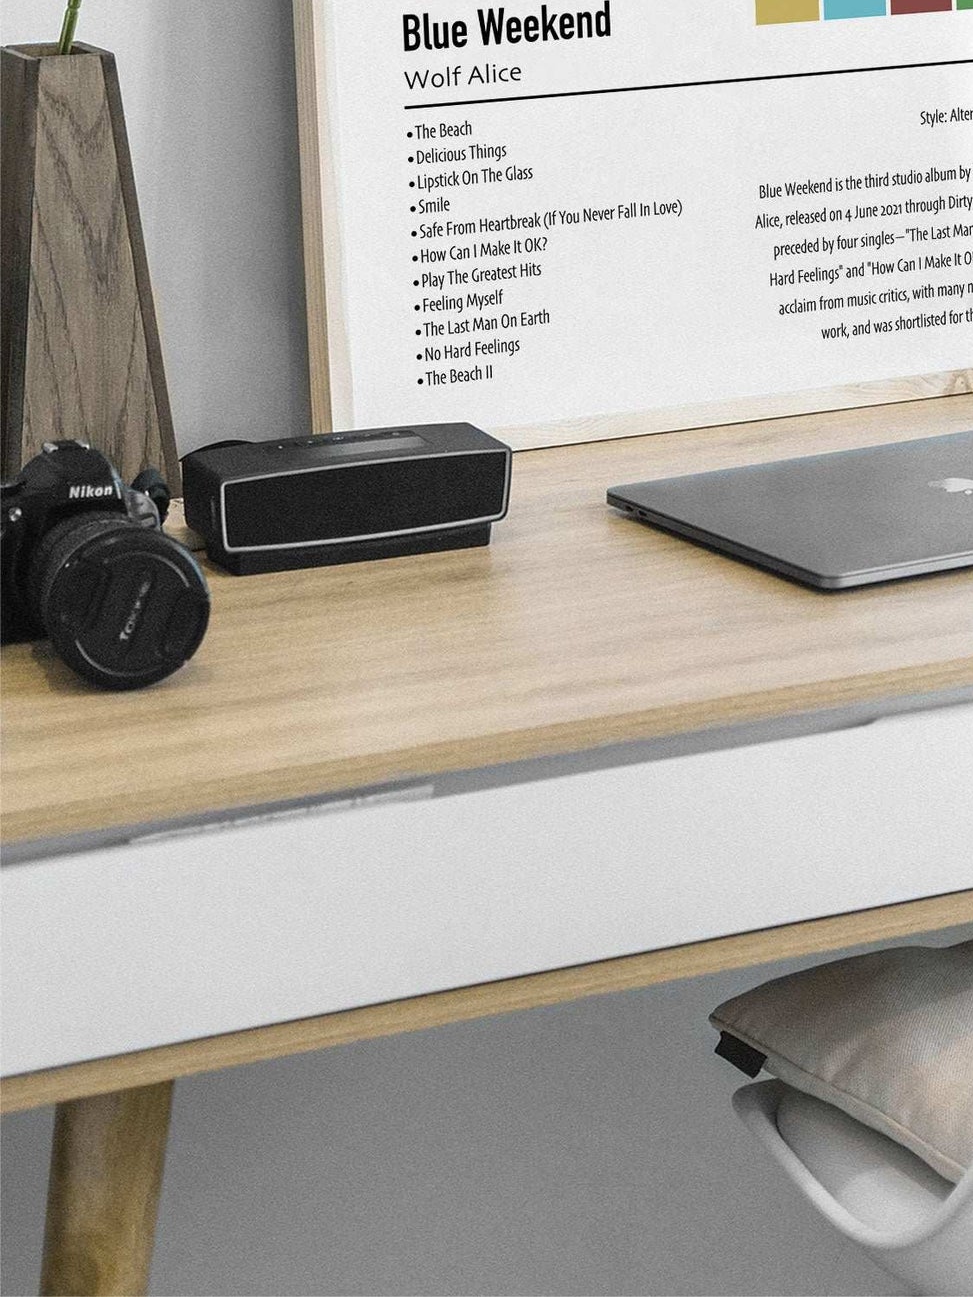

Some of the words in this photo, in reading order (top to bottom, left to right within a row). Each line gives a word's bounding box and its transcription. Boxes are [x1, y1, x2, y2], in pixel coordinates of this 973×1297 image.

[402, 12, 468, 53] Blue
[476, 0, 612, 46] Weekend
[403, 65, 462, 91] Wolf
[467, 62, 522, 86] Alice
[414, 123, 437, 140] The
[439, 119, 473, 139] Beach
[919, 108, 948, 129] Style:
[415, 147, 467, 165] Delicious
[467, 143, 507, 162] Things
[417, 170, 461, 194] Lipstick
[461, 169, 479, 186] On
[480, 166, 503, 184] The
[505, 164, 534, 182] Glass
[758, 183, 783, 200] Blue
[784, 176, 833, 197] Weekend
[834, 177, 844, 192] is
[845, 174, 863, 191] the
[864, 171, 890, 189] third
[891, 169, 923, 187] studio
[924, 166, 957, 184] album
[958, 164, 972, 183] by
[418, 195, 451, 215] Smile
[419, 221, 444, 240] Safe
[446, 220, 477, 237] From
[479, 211, 542, 233] Heartbreak
[543, 209, 558, 231] (If
[558, 210, 581, 226] You
[582, 207, 616, 223] Never
[617, 202, 637, 220] Fall
[639, 202, 651, 218] In
[653, 198, 683, 218] Love)
[754, 212, 784, 230] Alice,
[785, 206, 827, 227] released
[829, 209, 843, 222] on
[844, 208, 853, 223] 4
[854, 204, 879, 220] June
[880, 203, 903, 217] 2021
[904, 195, 946, 216] through
[948, 194, 973, 212] Dirty
[420, 248, 447, 264] How
[449, 245, 471, 261] Can
[473, 243, 478, 259] I
[479, 240, 511, 258] Make
[513, 239, 523, 255] It
[524, 236, 548, 254] OK?
[773, 237, 820, 262] preceded
[821, 236, 835, 256] by
[836, 234, 860, 251] four
[930, 225, 952, 240] Last
[421, 271, 446, 291] Play
[446, 268, 469, 286] The
[471, 265, 518, 283] Greatest
[519, 262, 542, 278] Hits
[769, 269, 796, 287] Hard
[797, 264, 844, 285] Feelings"
[845, 261, 865, 279] and
[866, 260, 895, 276] "How
[896, 258, 916, 273] Can
[918, 256, 922, 271] I
[924, 252, 953, 270] Make
[953, 252, 963, 267] It
[422, 294, 464, 314] Feeling
[466, 288, 504, 312] Myself
[778, 297, 817, 316] acclaim
[818, 295, 845, 311] from
[846, 290, 877, 308] music
[878, 287, 911, 304] critics,
[911, 283, 935, 300] with
[937, 283, 966, 299] many
[422, 320, 445, 338] The
[447, 318, 471, 335] Last
[472, 316, 498, 333] Man
[500, 313, 518, 329] On
[520, 308, 551, 327] Earth
[820, 322, 850, 340] work,
[852, 318, 871, 337] and
[872, 320, 894, 334] was
[894, 310, 947, 332] shortlisted
[948, 309, 964, 325] for
[424, 346, 442, 362] No
[443, 340, 472, 360] Hard
[474, 338, 521, 357] Feelings
[424, 369, 447, 387] The
[449, 364, 483, 384] Beach
[485, 364, 493, 380] II
[69, 485, 113, 499] Nikon
